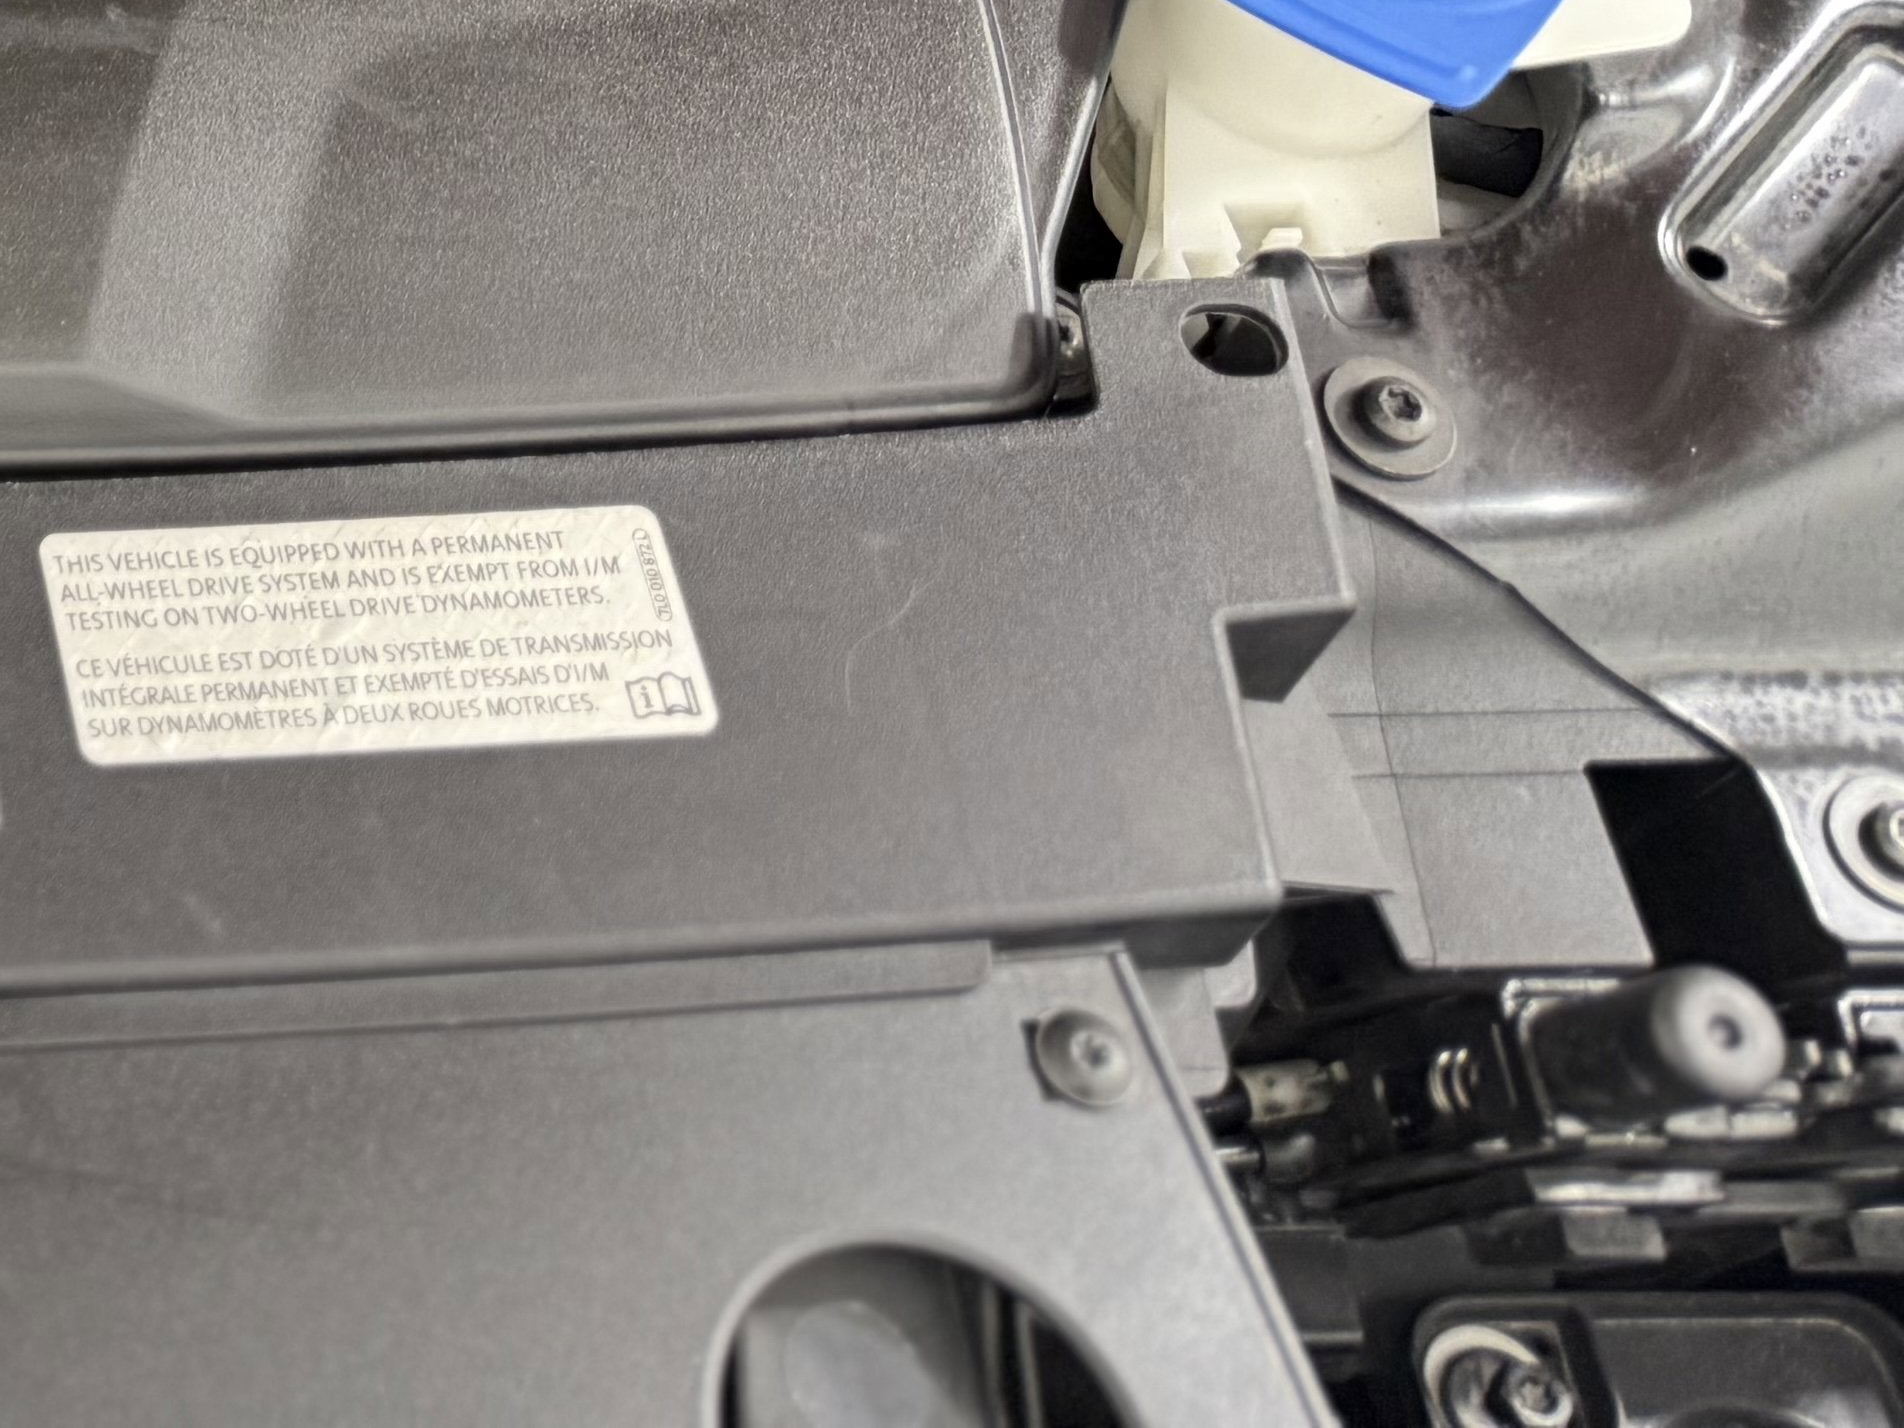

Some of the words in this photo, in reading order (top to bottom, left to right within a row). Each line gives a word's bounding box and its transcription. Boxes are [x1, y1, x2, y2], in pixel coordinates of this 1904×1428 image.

[53, 554, 104, 574] THIS
[107, 549, 200, 572] VEHICLE
[205, 548, 225, 568] IS
[230, 542, 340, 569] EQUIPPED
[346, 537, 405, 560] WITH
[411, 537, 427, 557] A
[431, 530, 564, 556] PERMANENT
[60, 579, 185, 603] ALL-WHEEL
[187, 575, 254, 598] DRIVE
[258, 570, 340, 593] SYSTEM
[346, 568, 396, 589] AND
[402, 566, 422, 585] IS
[427, 561, 510, 584] EXEMPT
[516, 558, 579, 579] FROM
[585, 555, 621, 576] I/M
[65, 607, 158, 631] TESTING
[163, 606, 199, 628] ON
[202, 598, 346, 624] TWO-WHEEL
[349, 595, 417, 617] DRIVE
[421, 585, 611, 614] DYNAMOMETERS.
[76, 658, 105, 678] CE
[107, 652, 213, 678] VÉHICULE
[218, 652, 253, 672] EST
[259, 644, 318, 670] DOTÉ
[322, 645, 378, 665] D'UN
[383, 636, 476, 665] SYSTÈME
[480, 638, 509, 659] DE
[511, 628, 673, 656] TRANSMISSION
[82, 683, 202, 708] INTÉGRALE
[201, 677, 330, 704] PERMANENT
[336, 675, 359, 695] ET
[364, 666, 458, 695] EXEMPTÉ
[461, 665, 548, 689] D'ESSAIS
[554, 662, 610, 684] D'I/M
[86, 717, 133, 738] SUR
[137, 706, 317, 736] DYNAMOMÈTRES
[322, 702, 340, 725] À
[343, 703, 404, 725] DEUX
[408, 696, 482, 722] ROUES
[486, 692, 600, 717] MOTRICES.
